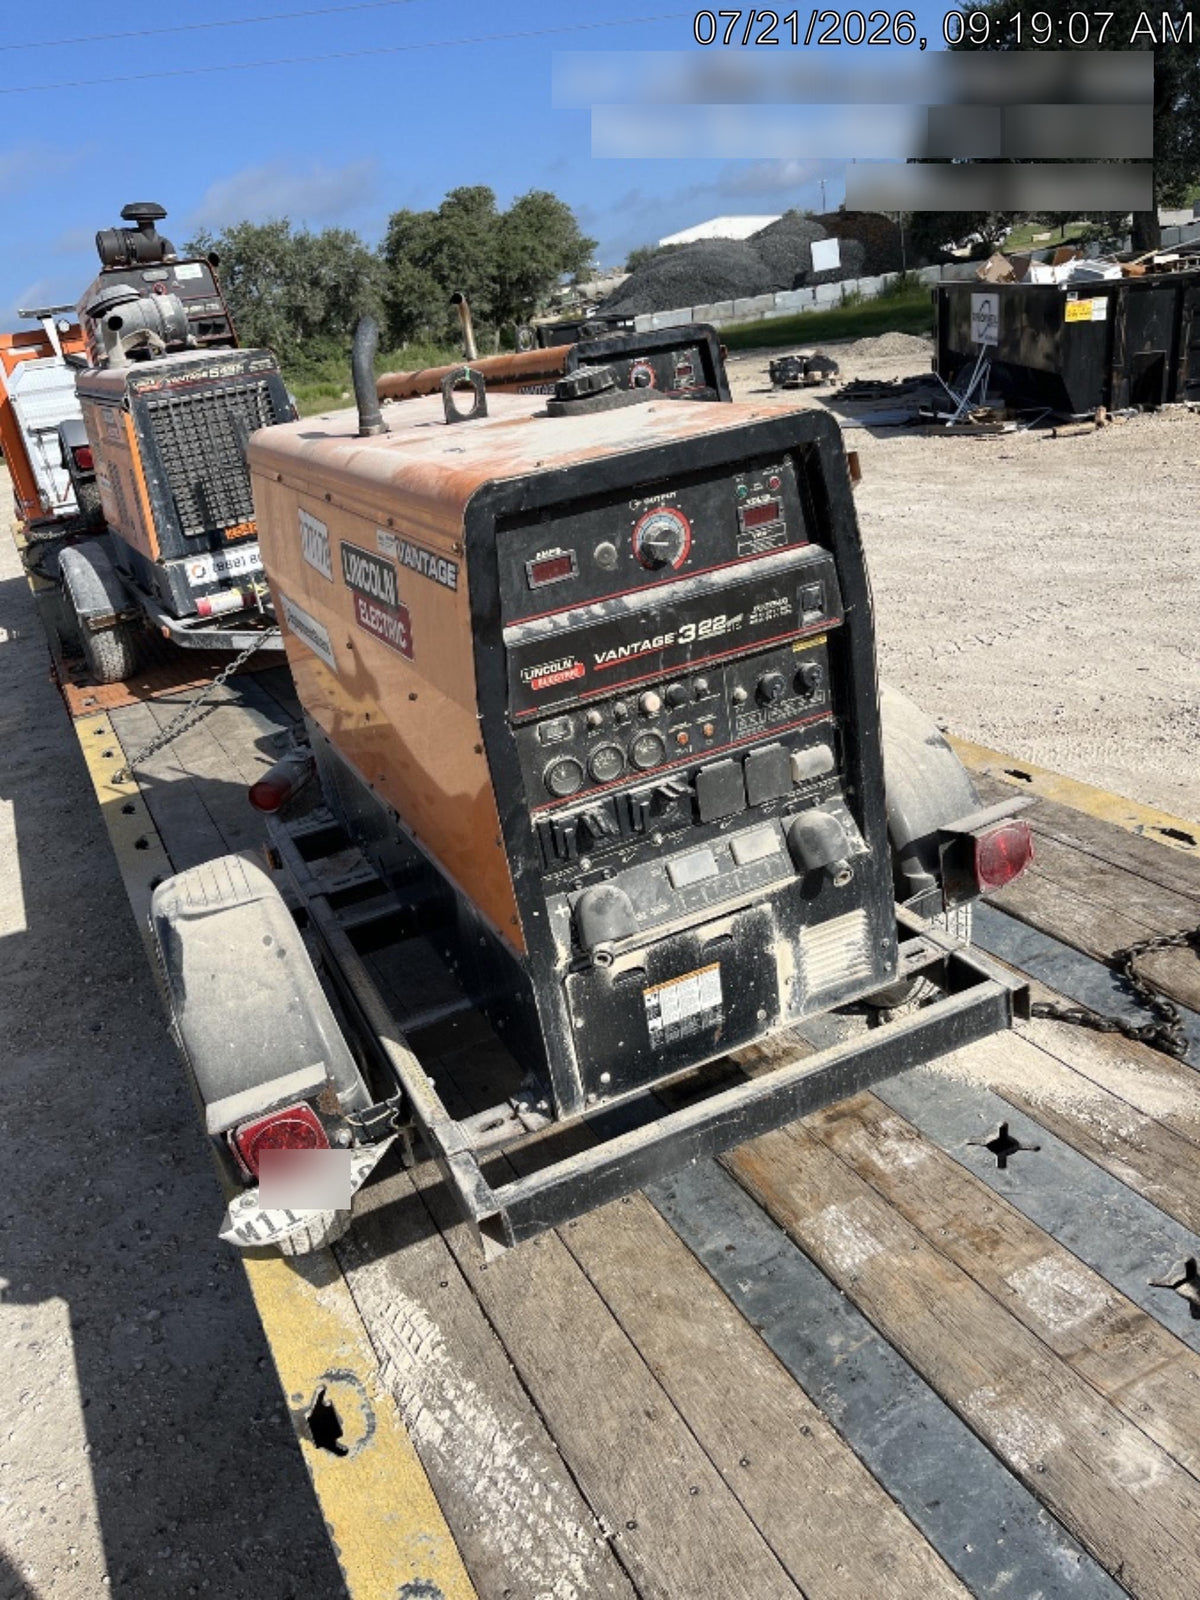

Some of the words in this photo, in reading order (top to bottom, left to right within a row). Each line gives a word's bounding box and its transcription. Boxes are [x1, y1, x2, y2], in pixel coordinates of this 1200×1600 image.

[343, 548, 396, 606] LINCOLN
[396, 539, 457, 590] VANTAGE
[358, 598, 408, 650] ELECTRIC
[594, 631, 676, 664] VANTAGE
[678, 614, 727, 645] 322
[525, 659, 573, 681] LINCOLN
